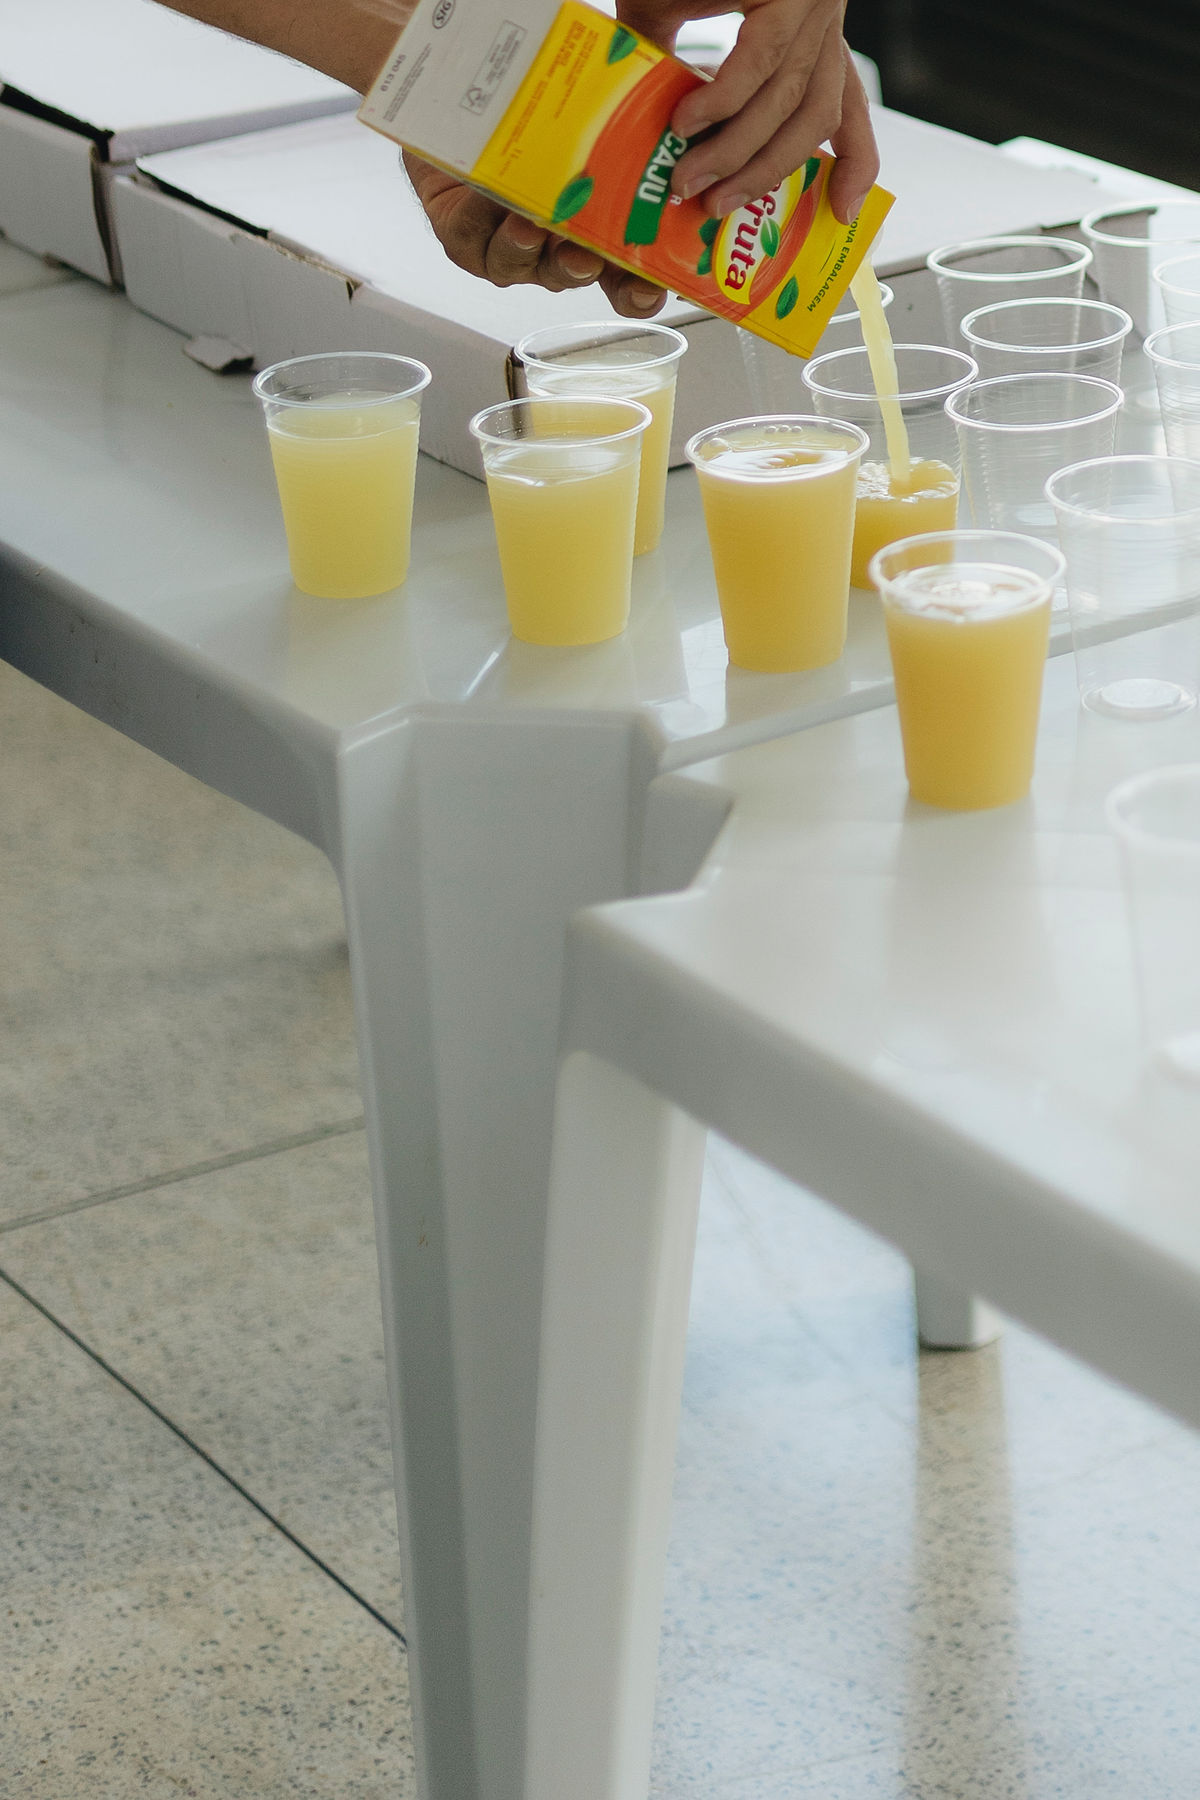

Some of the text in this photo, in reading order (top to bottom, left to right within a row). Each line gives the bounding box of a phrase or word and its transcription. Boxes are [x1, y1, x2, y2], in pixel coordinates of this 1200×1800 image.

[435, 0, 453, 25] SIG
[638, 131, 688, 204] CAJU
[725, 182, 782, 290] fruta
[806, 246, 850, 312] EMBALAGEM
